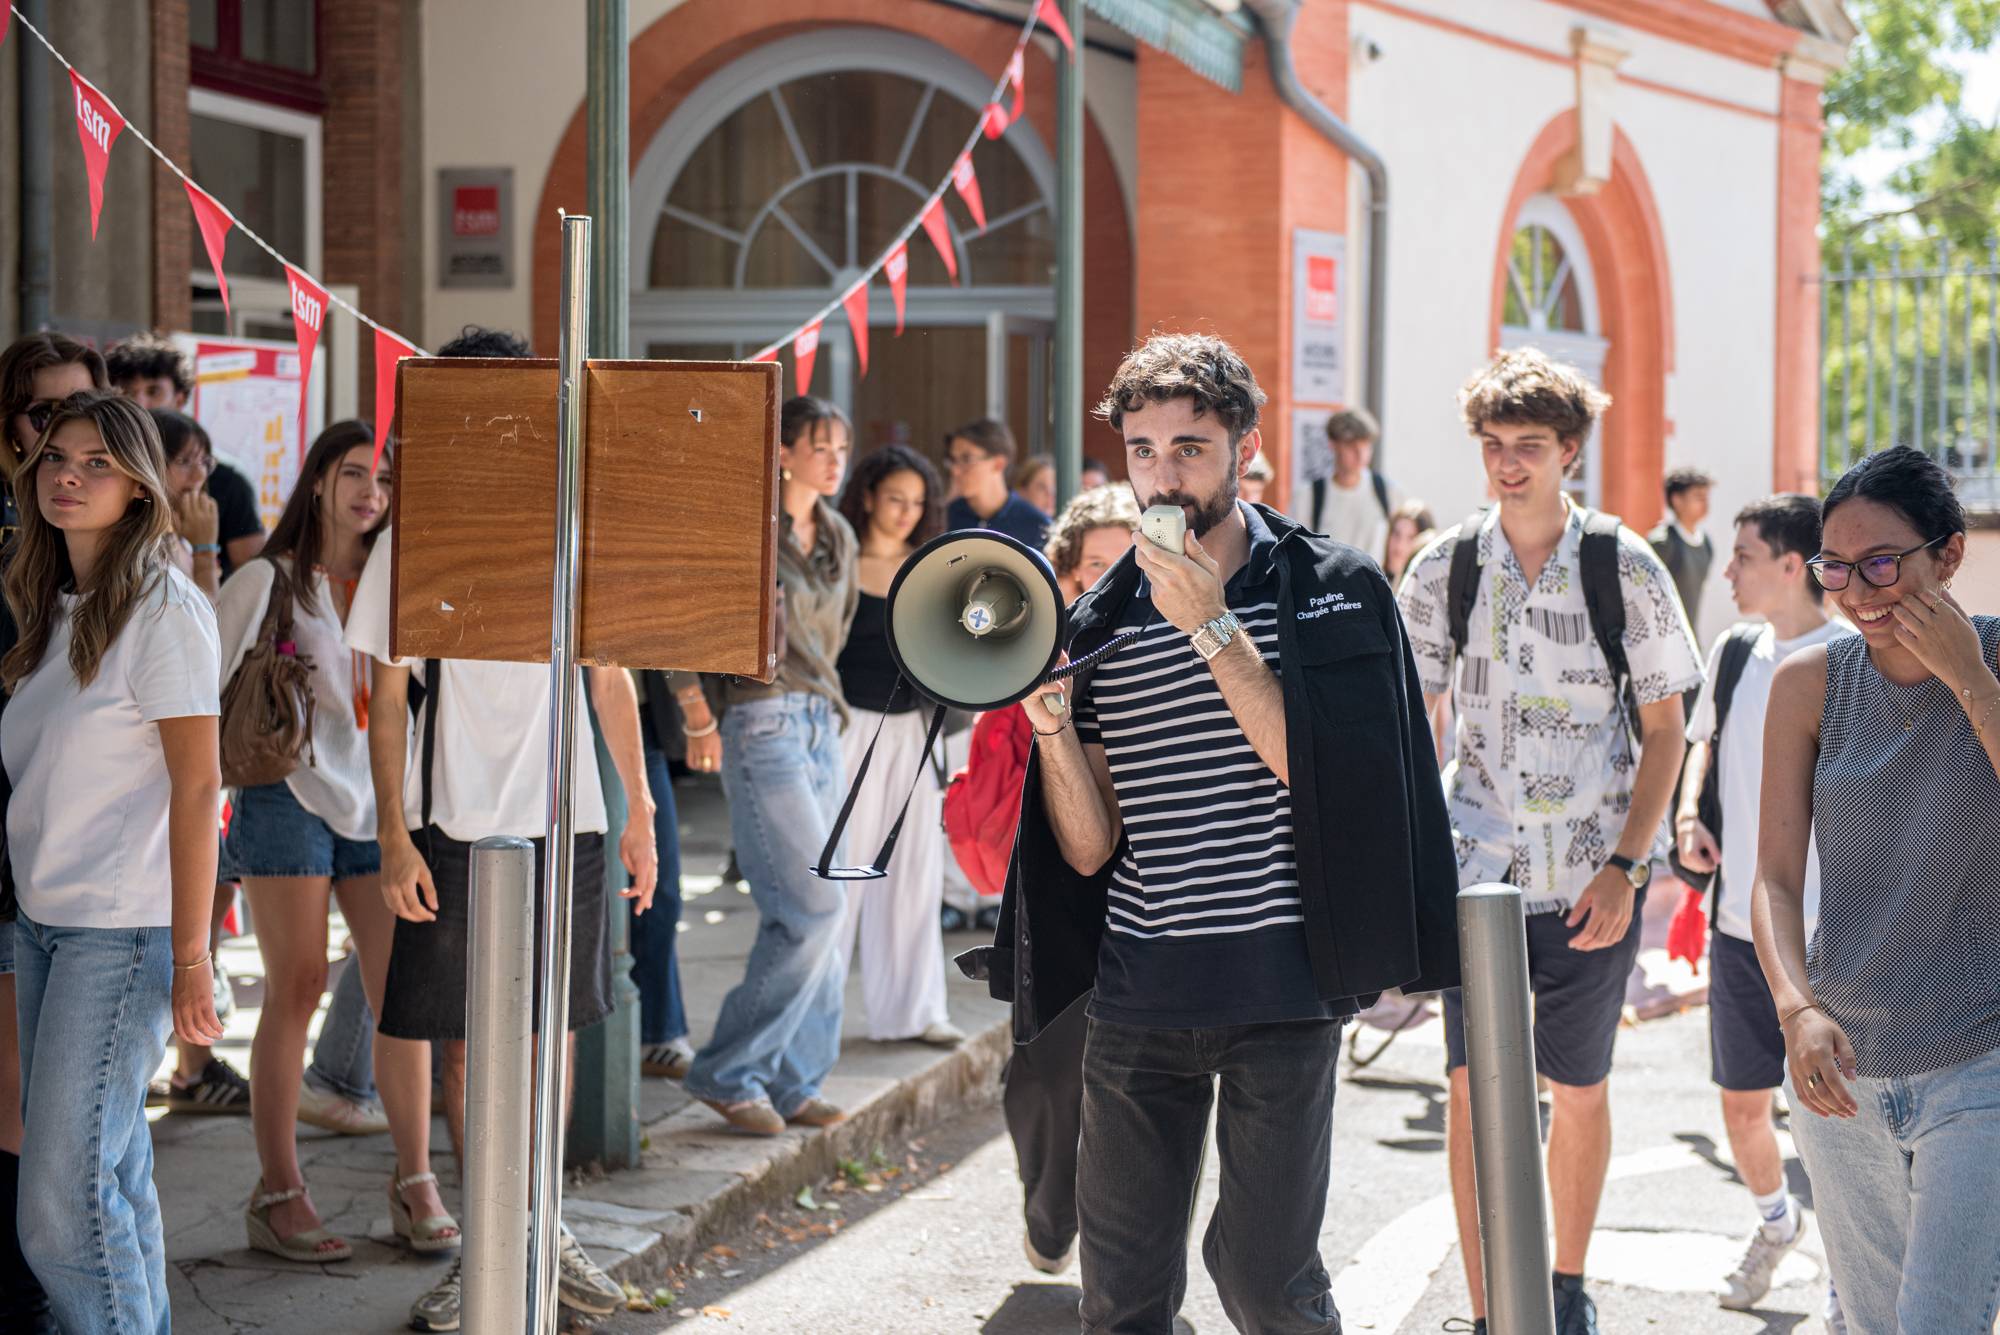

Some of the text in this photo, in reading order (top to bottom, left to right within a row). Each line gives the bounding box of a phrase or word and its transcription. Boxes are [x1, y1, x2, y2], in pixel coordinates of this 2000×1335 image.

[76, 84, 110, 154] tsm
[291, 280, 321, 332] tsm
[1296, 602, 1362, 620] Chargée affaires
[1309, 592, 1345, 608] Pauline
